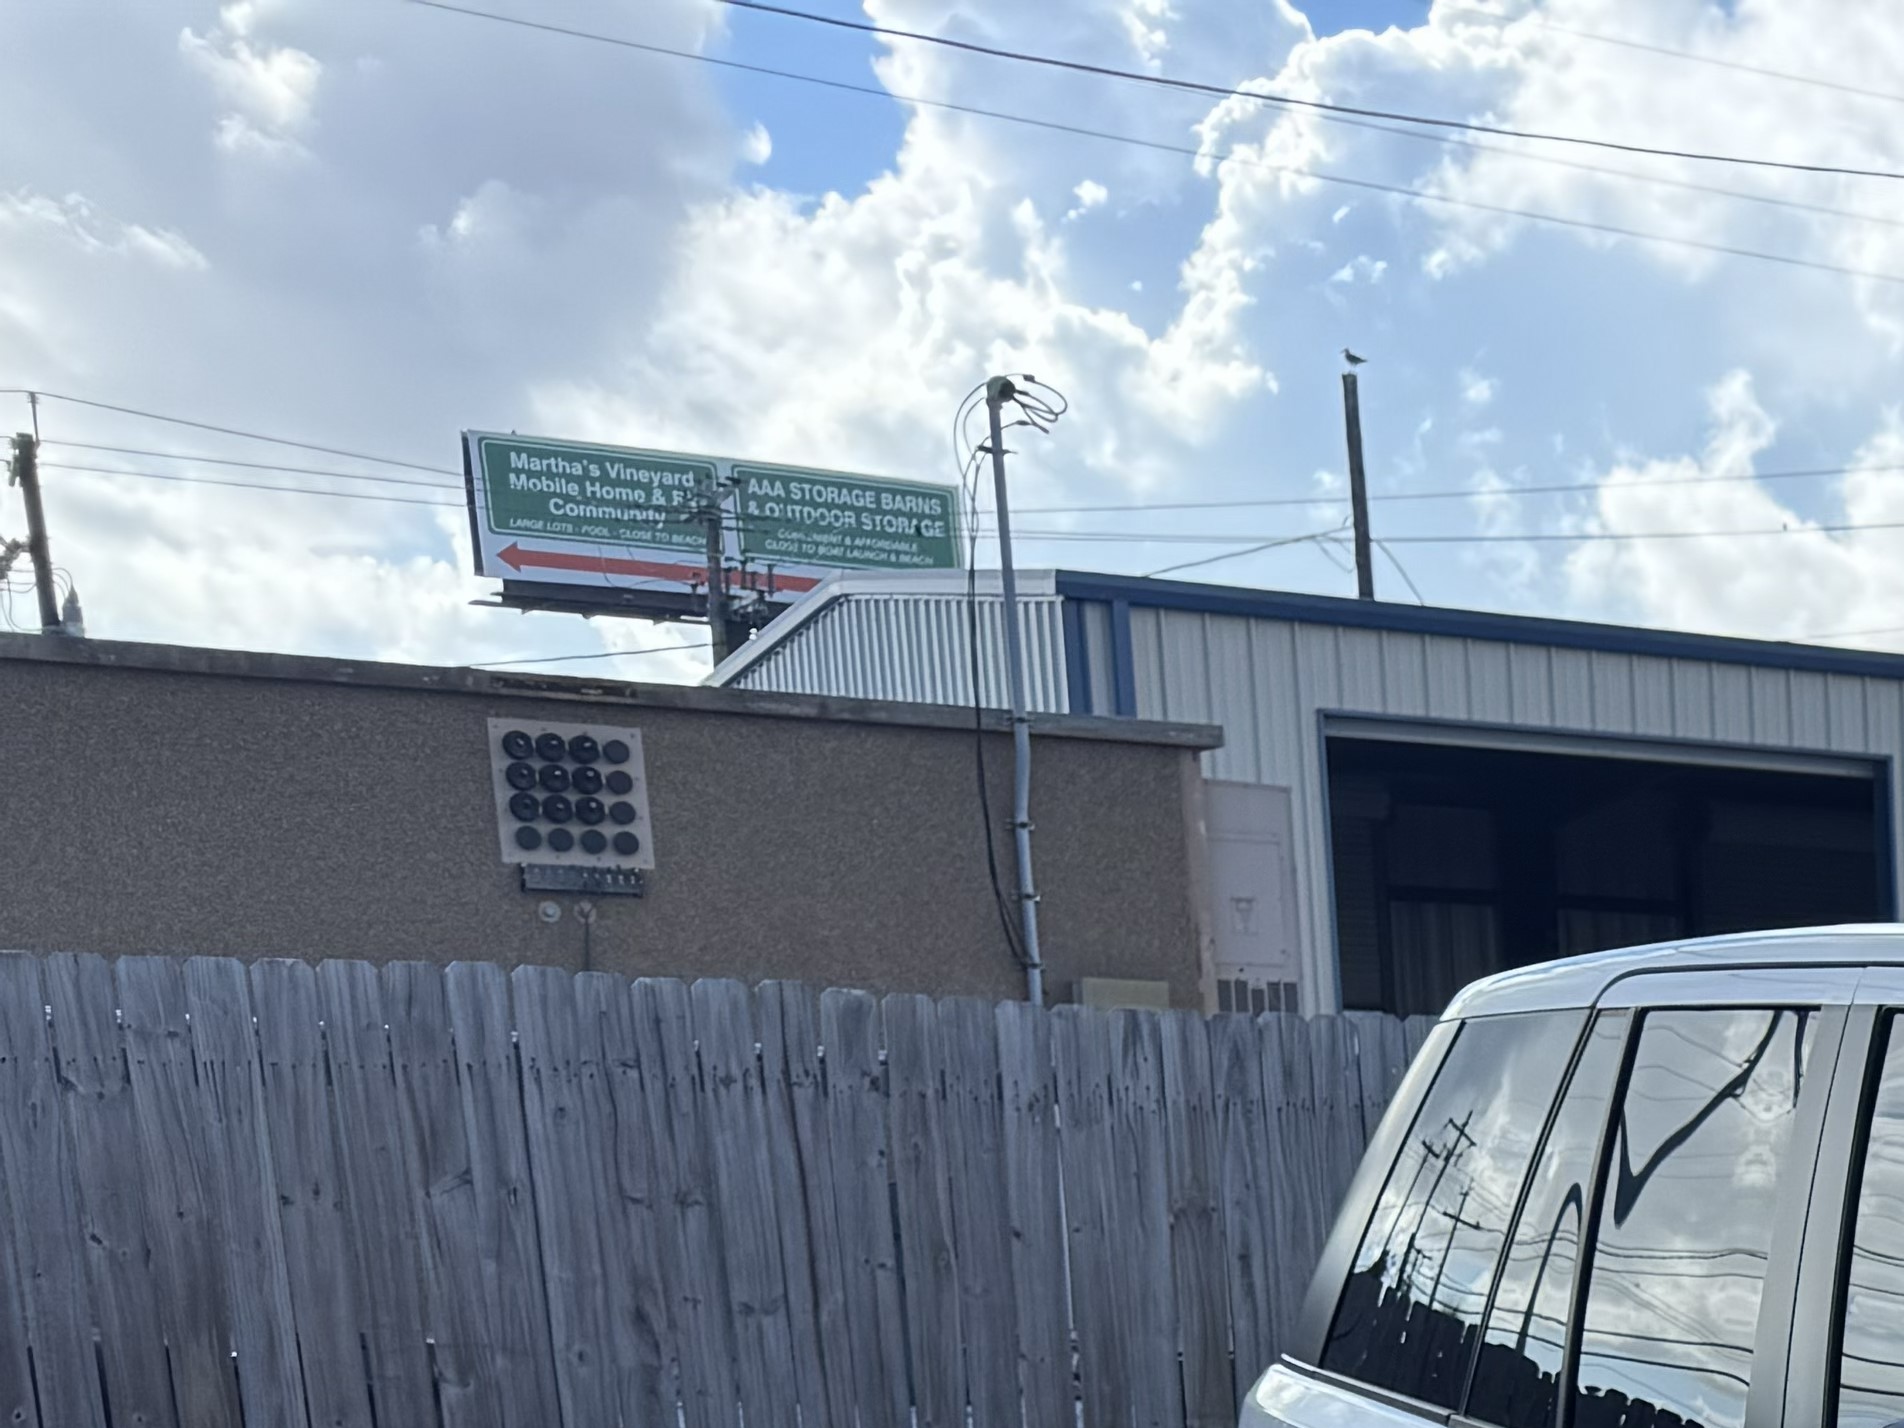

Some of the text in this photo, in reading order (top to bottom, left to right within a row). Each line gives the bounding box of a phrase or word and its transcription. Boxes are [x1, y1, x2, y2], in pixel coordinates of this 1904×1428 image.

[510, 451, 694, 488] Martha's Vineyard
[509, 473, 580, 496] Mobile
[585, 481, 646, 503] Home
[652, 488, 667, 505] &
[748, 478, 942, 515] AAA STORAGE BARNS
[509, 518, 543, 530] LARGE
[619, 528, 652, 541] CLOSE
[654, 532, 670, 542] TO
[549, 498, 666, 528] Community
[748, 501, 760, 516] &
[861, 513, 945, 538] STORAGE
